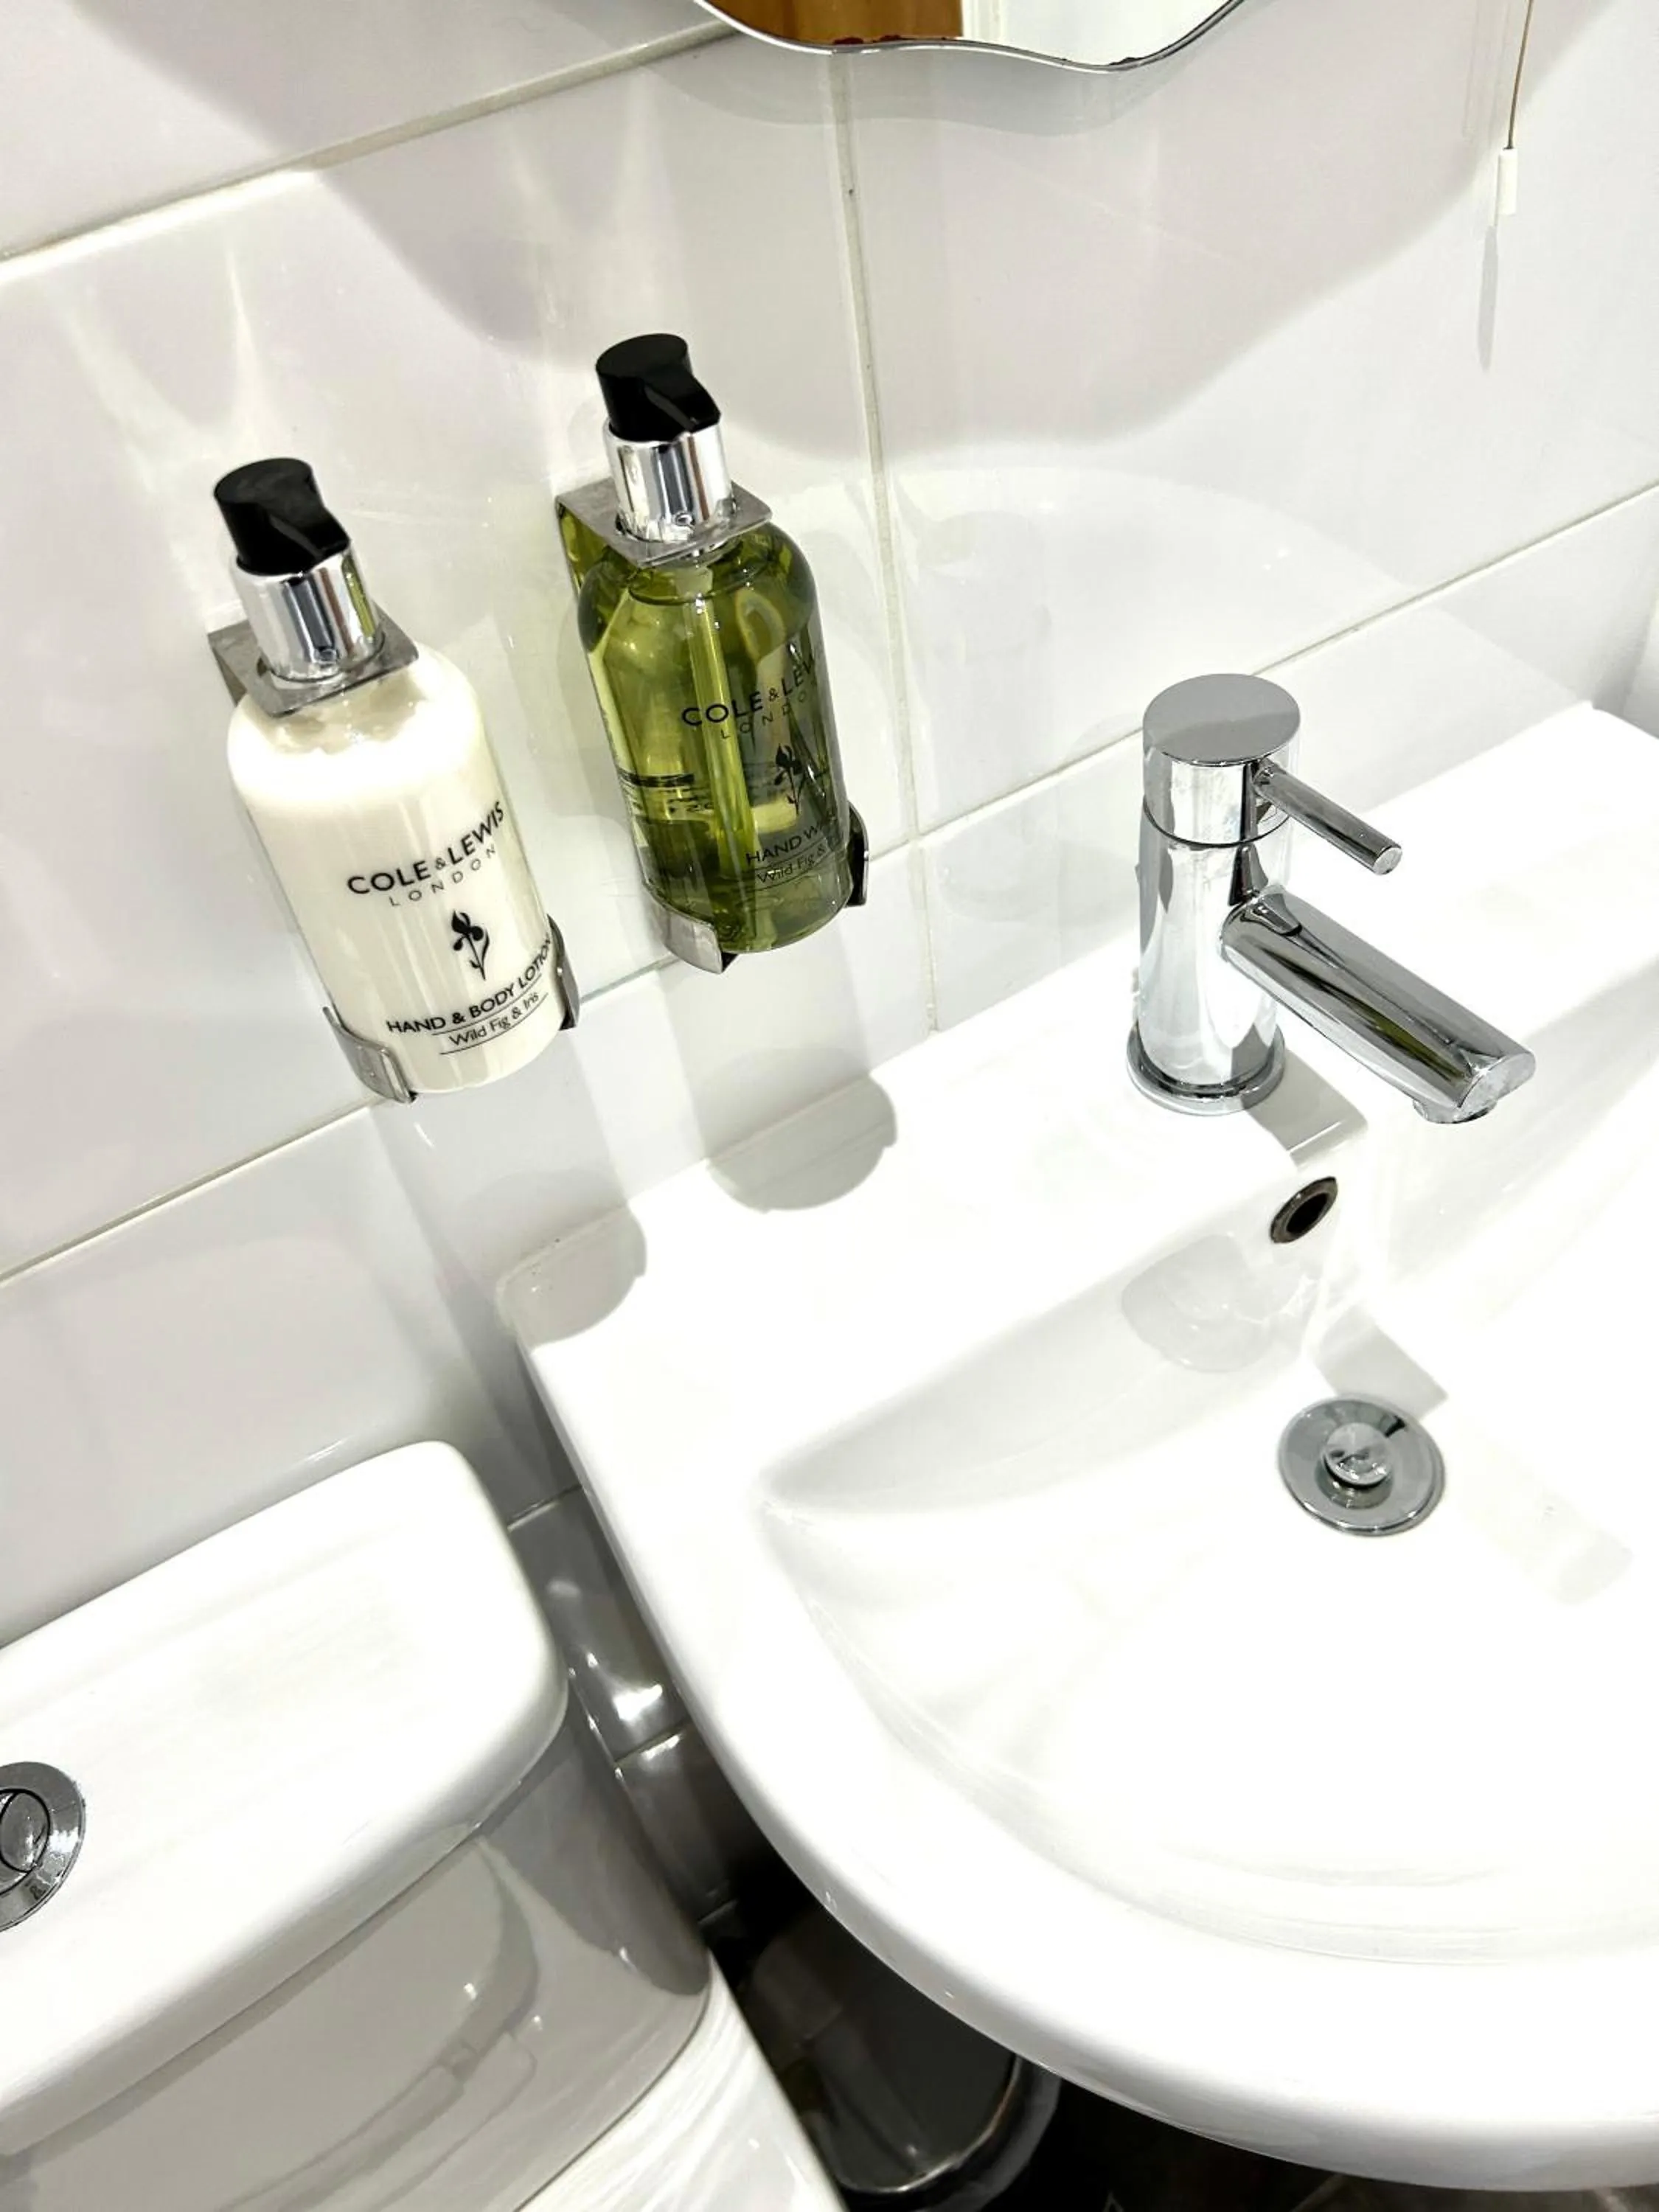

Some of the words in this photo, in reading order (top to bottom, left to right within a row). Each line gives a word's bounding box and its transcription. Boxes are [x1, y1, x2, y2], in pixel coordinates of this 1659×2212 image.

[720, 687, 810, 740] LONDO
[347, 860, 431, 894] COLE
[448, 801, 504, 865] LEWIS
[745, 834, 802, 866] HAND
[389, 844, 495, 906] LONDON
[386, 1015, 447, 1034] HAND
[452, 1012, 467, 1025] &
[469, 982, 515, 1019] BODY
[448, 1028, 487, 1046] Wild
[489, 1015, 512, 1032] Fig
[511, 1006, 522, 1020] &
